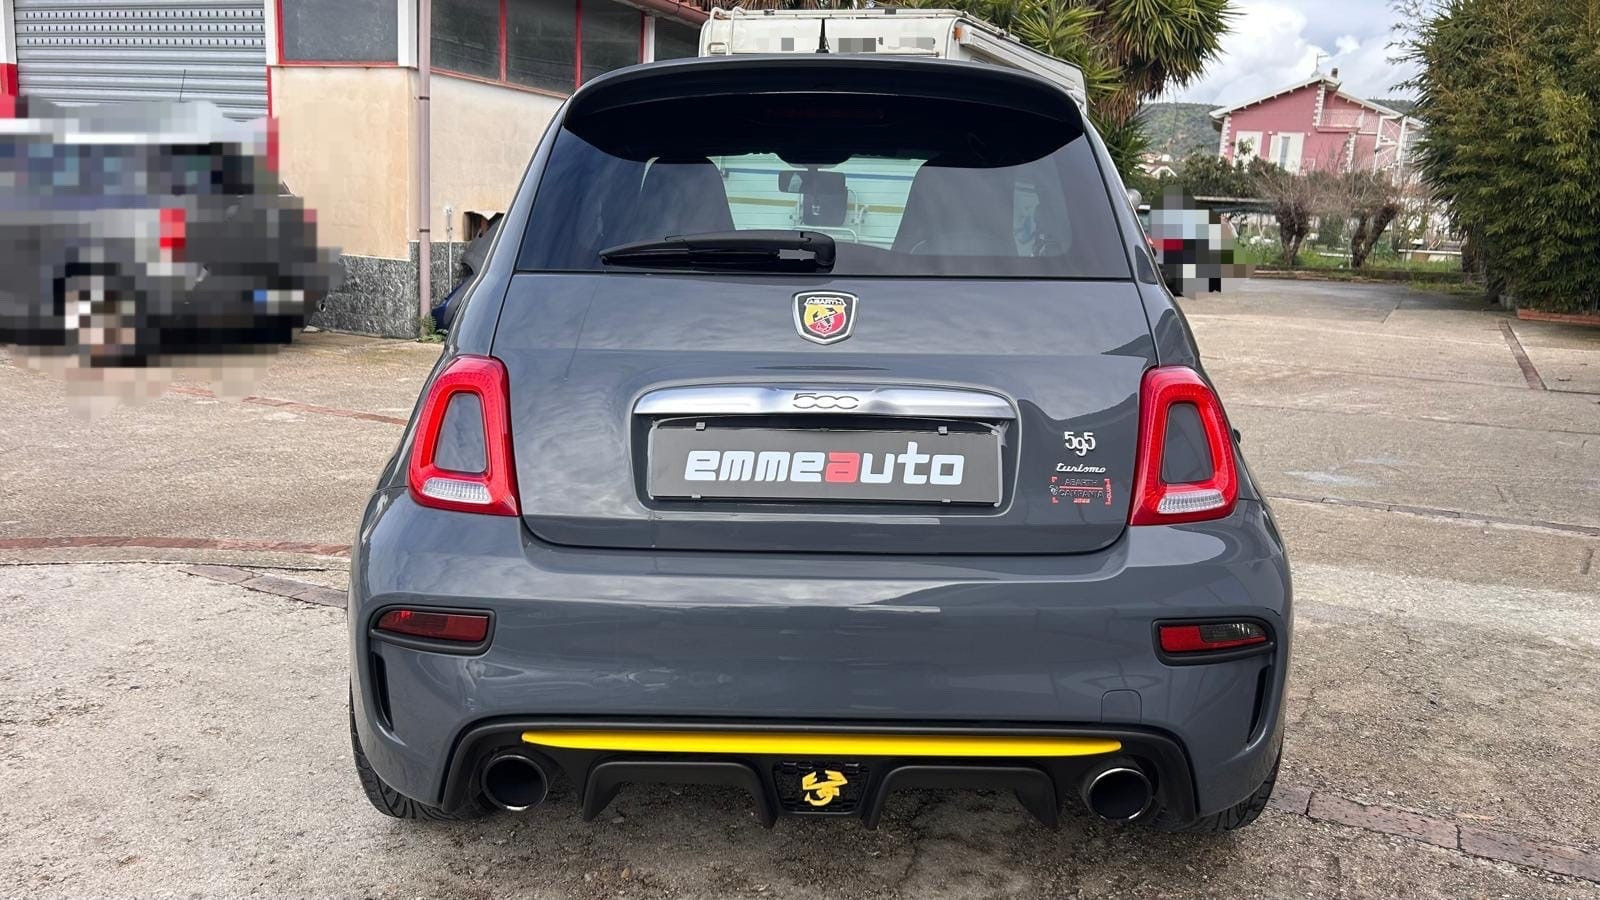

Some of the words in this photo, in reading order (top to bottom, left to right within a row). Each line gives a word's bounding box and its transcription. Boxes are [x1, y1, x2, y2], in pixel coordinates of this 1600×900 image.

[793, 392, 859, 409] 500
[1064, 431, 1096, 456] 595
[684, 441, 965, 485] emmeauto
[1056, 463, 1106, 473] turismo
[1064, 478, 1098, 486] ABARTH
